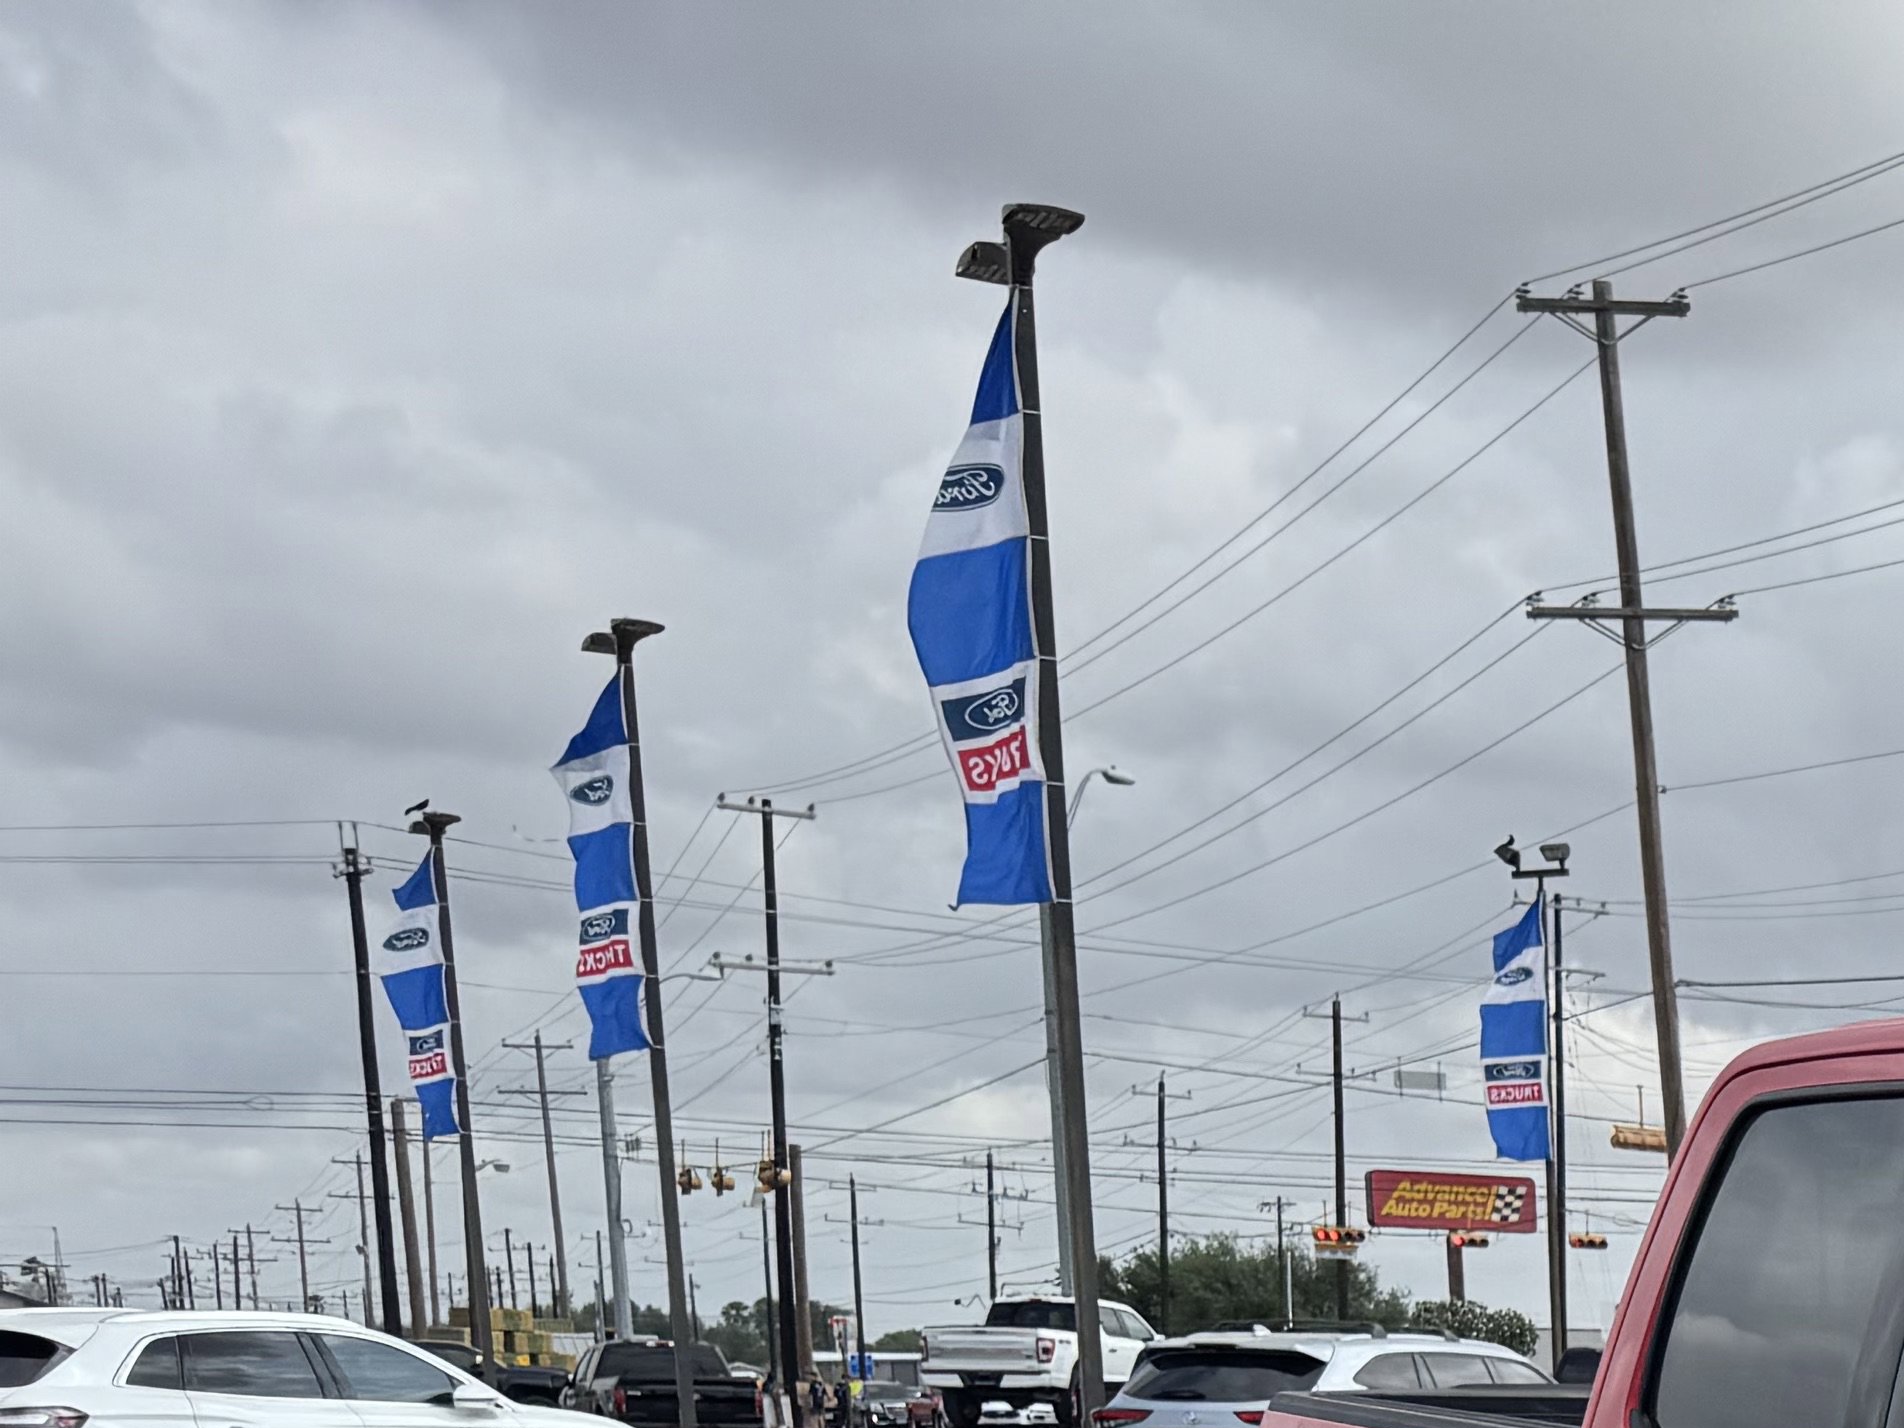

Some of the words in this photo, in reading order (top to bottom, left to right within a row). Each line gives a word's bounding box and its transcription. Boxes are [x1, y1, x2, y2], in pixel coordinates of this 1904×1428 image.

[1392, 1181, 1489, 1203] Advance
[1381, 1199, 1431, 1217] Auto
[1432, 1201, 1485, 1220] Parts
